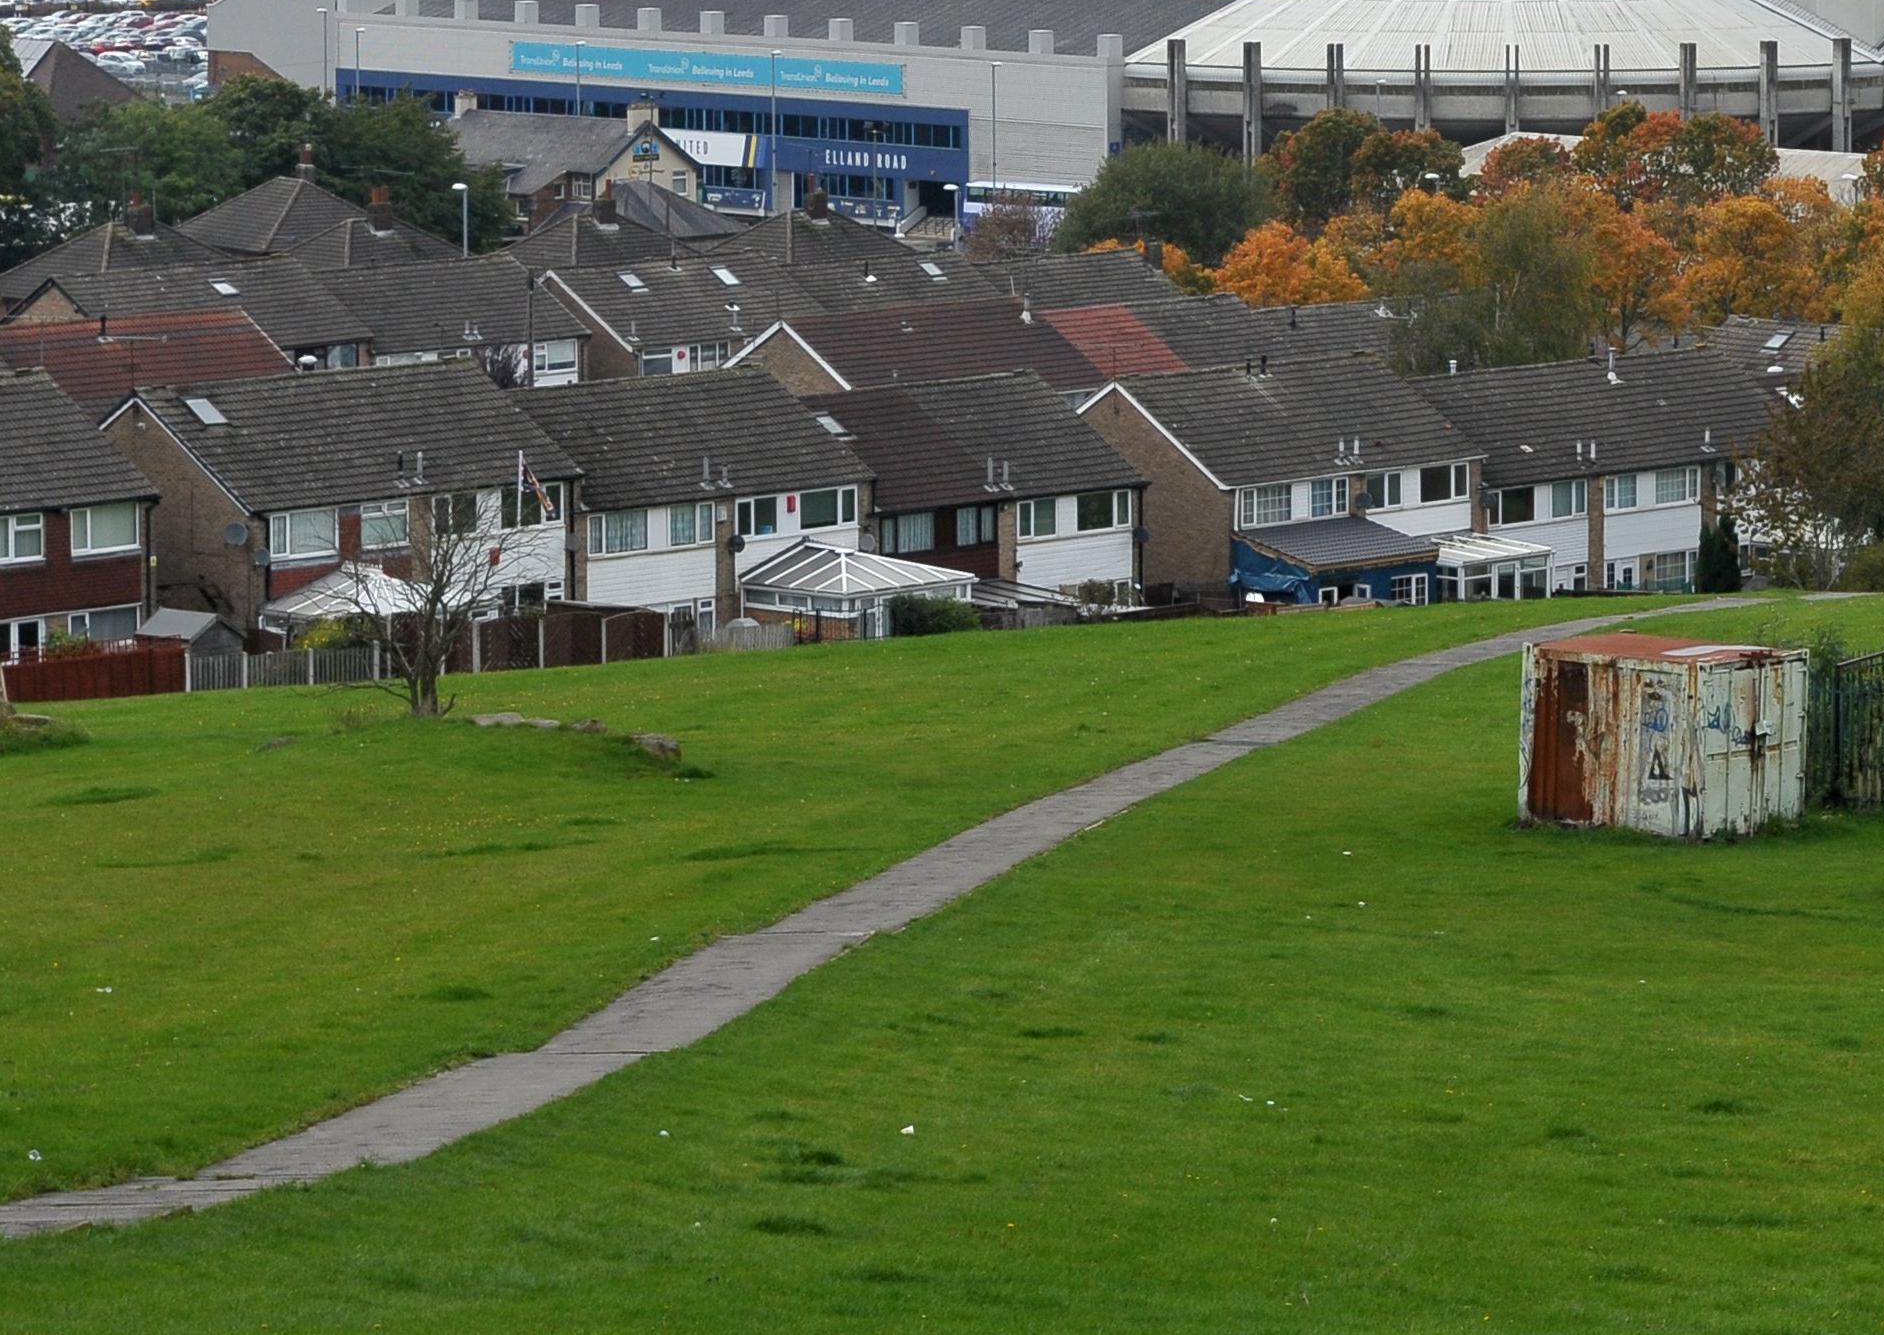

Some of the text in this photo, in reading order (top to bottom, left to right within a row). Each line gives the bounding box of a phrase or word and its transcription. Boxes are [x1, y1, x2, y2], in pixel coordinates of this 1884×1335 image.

[562, 58, 593, 71] Believing
[603, 60, 623, 70] Leeds
[692, 65, 724, 79] Believing
[733, 68, 754, 78] Leeds
[825, 73, 859, 87] Believing
[868, 76, 889, 87] Leeds
[825, 149, 907, 170] ELLAND ROAD
